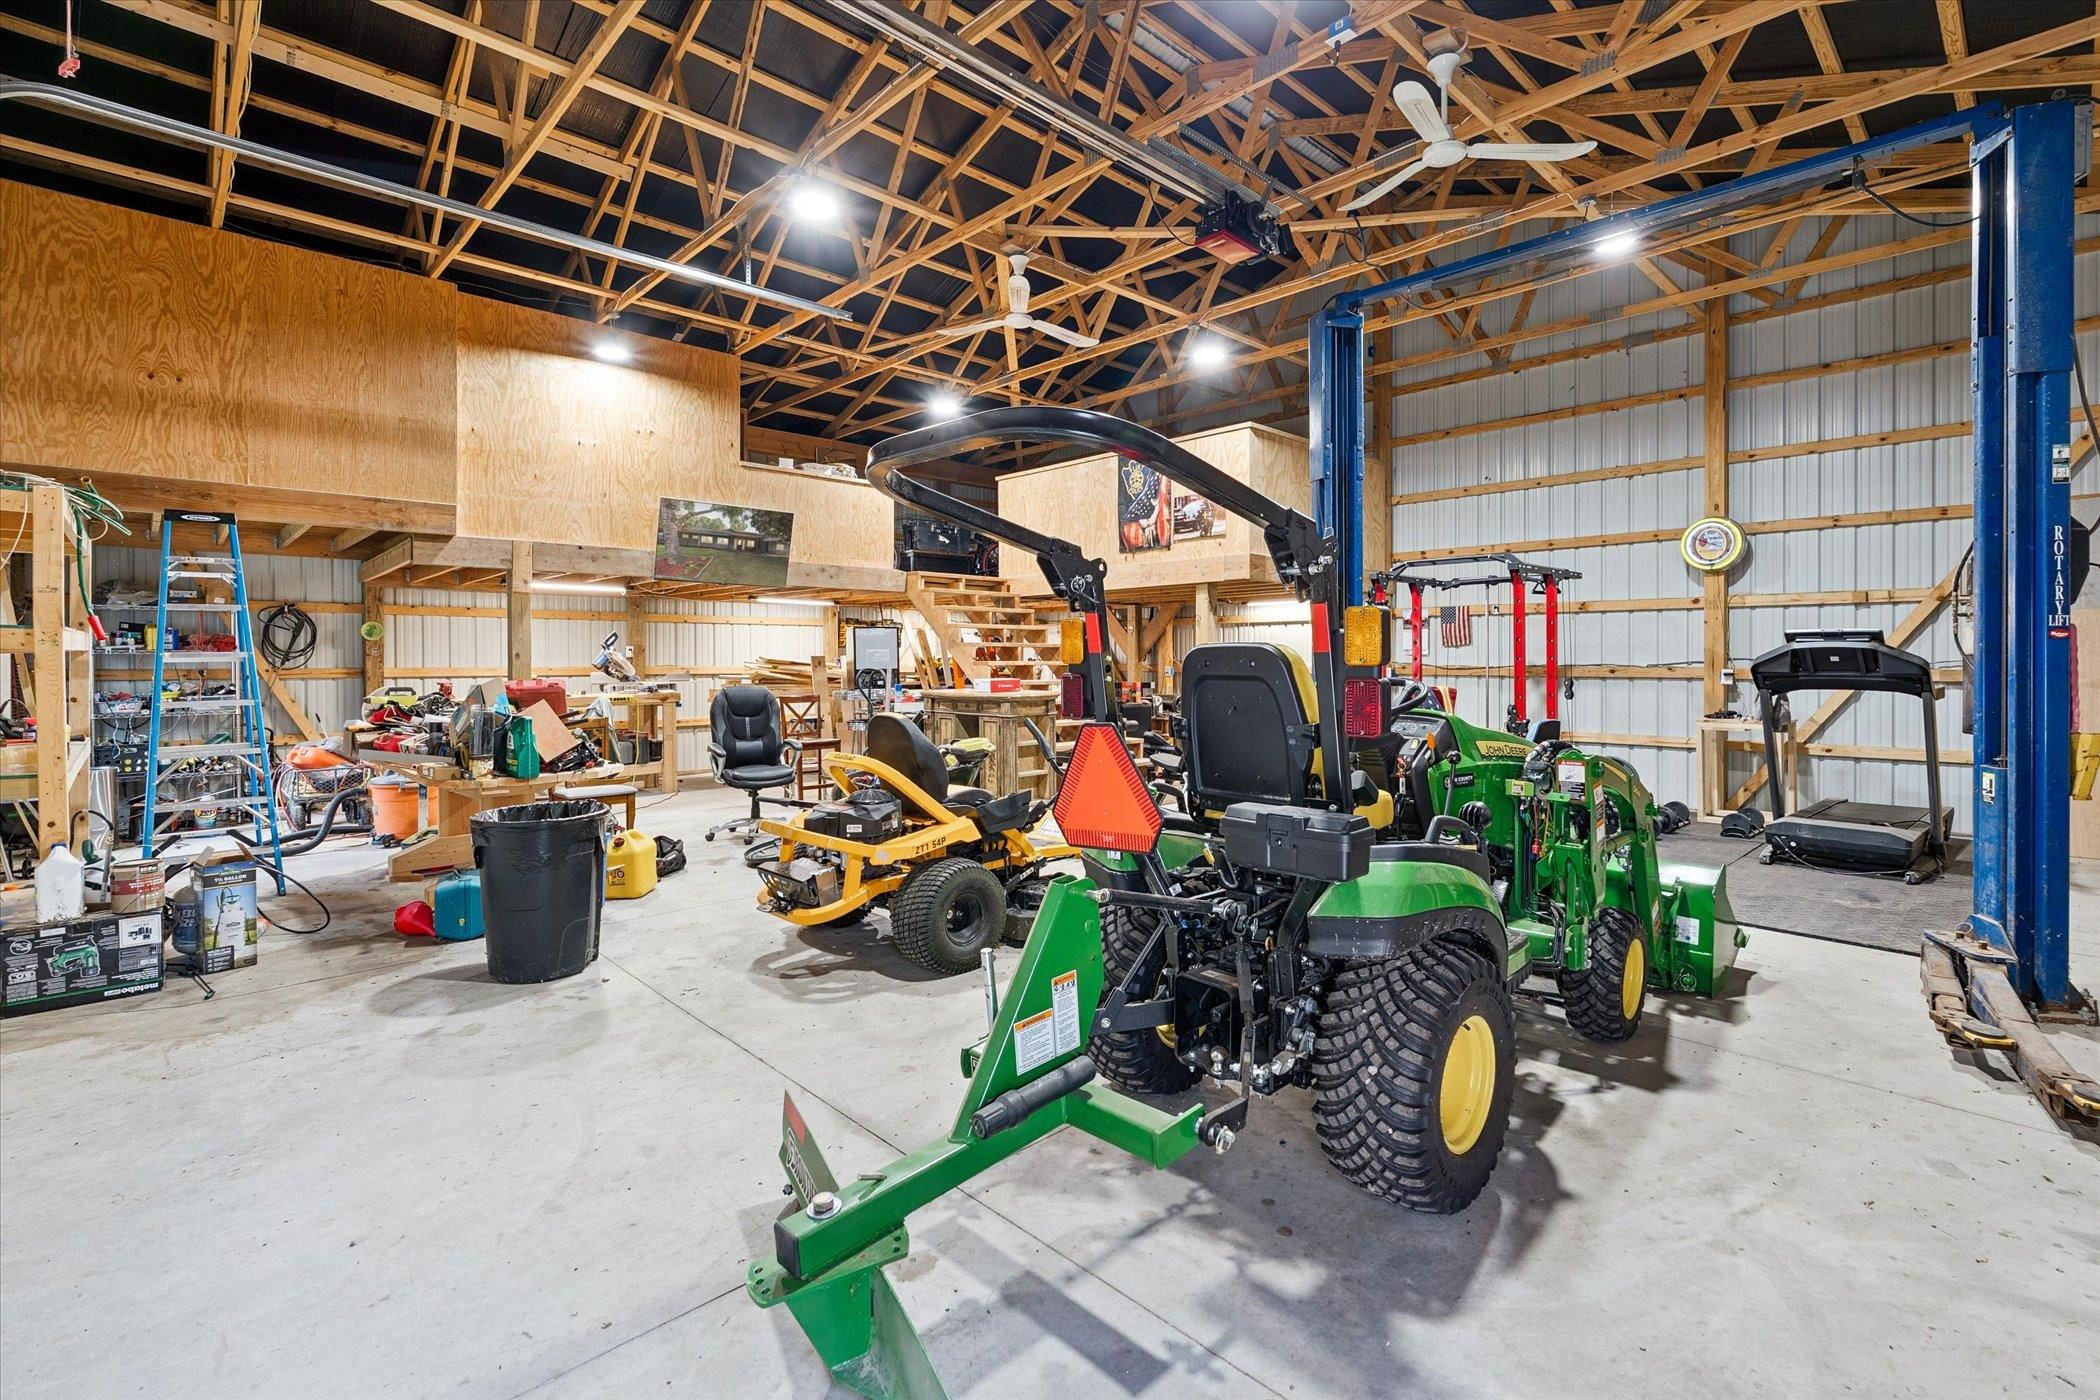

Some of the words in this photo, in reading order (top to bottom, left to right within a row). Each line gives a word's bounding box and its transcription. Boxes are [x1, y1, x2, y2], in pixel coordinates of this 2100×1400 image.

[2053, 525, 2065, 615] ROTARY
[2048, 614, 2070, 626] LIFT
[1485, 744, 1505, 755] JOHN
[1505, 745, 1528, 756] DEERE
[915, 843, 929, 855] ZT1
[932, 836, 947, 849] 54P
